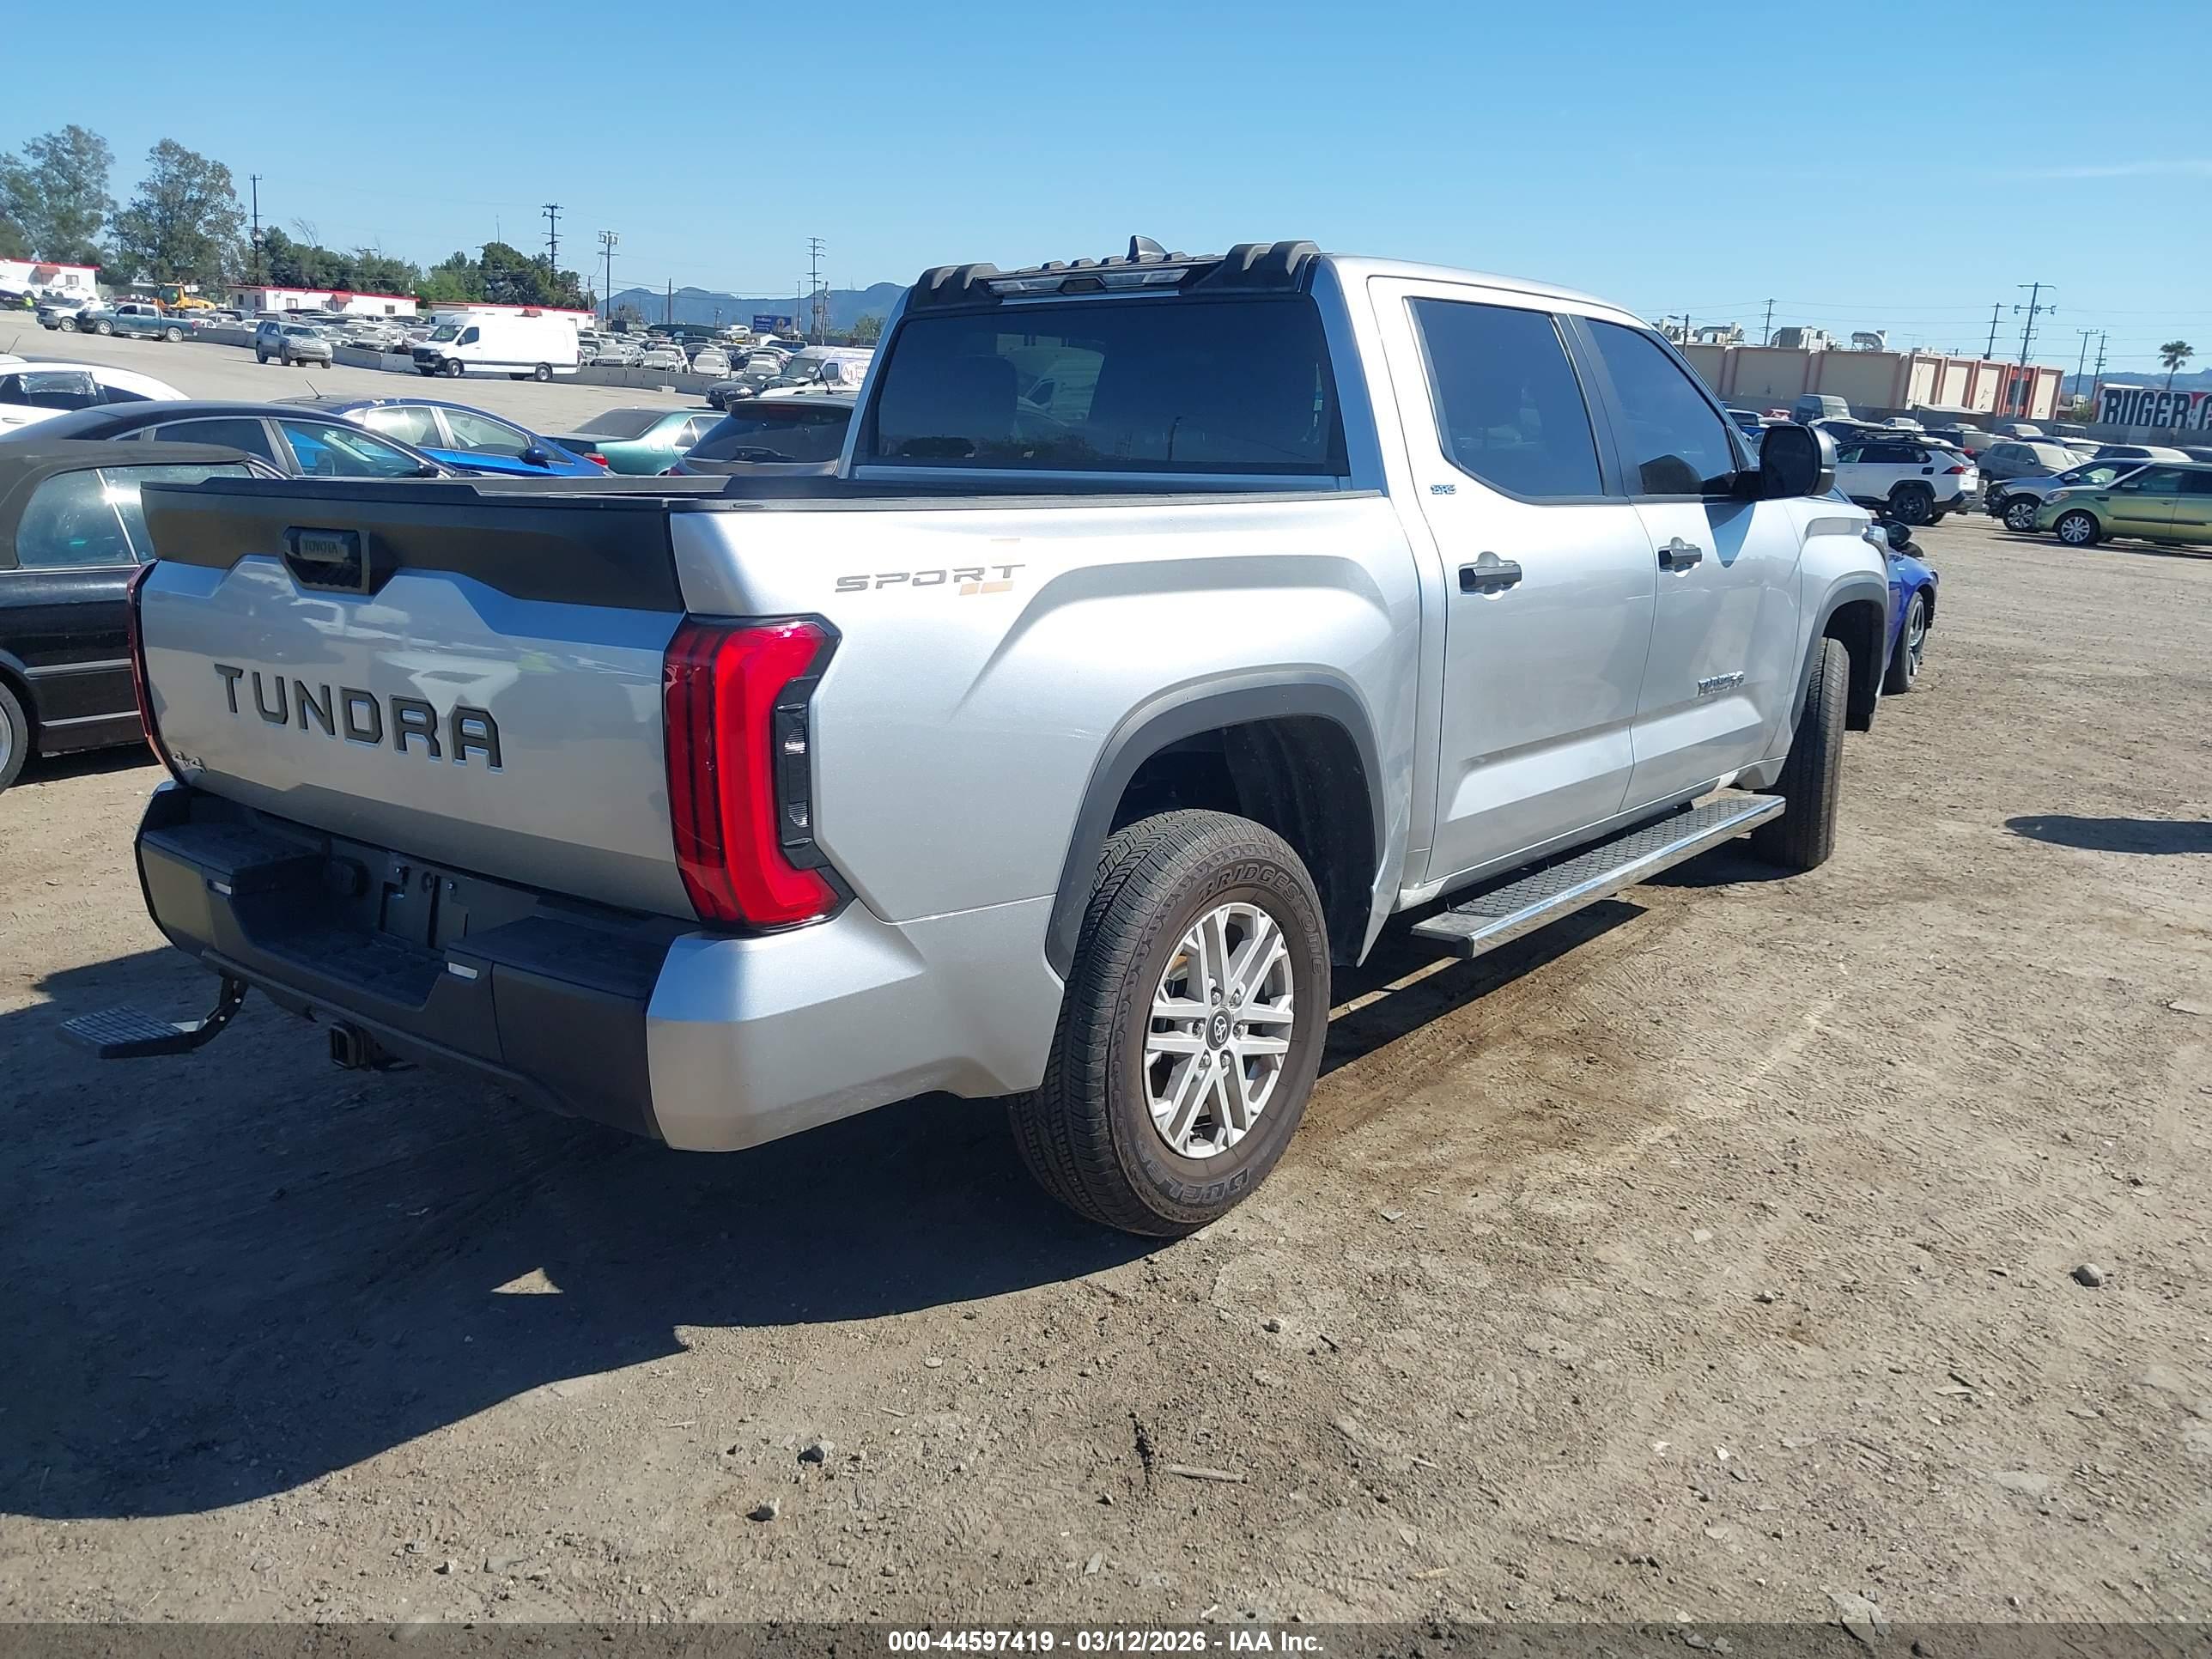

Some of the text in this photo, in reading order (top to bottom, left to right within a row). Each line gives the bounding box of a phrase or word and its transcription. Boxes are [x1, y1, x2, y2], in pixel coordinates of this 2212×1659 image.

[302, 539, 339, 555] TOYOTA
[835, 563, 1026, 593] SPORT
[213, 663, 504, 775] TUNDRA
[1198, 862, 1325, 975] BRIDGESTONE
[1134, 1139, 1250, 1204] DUELER
